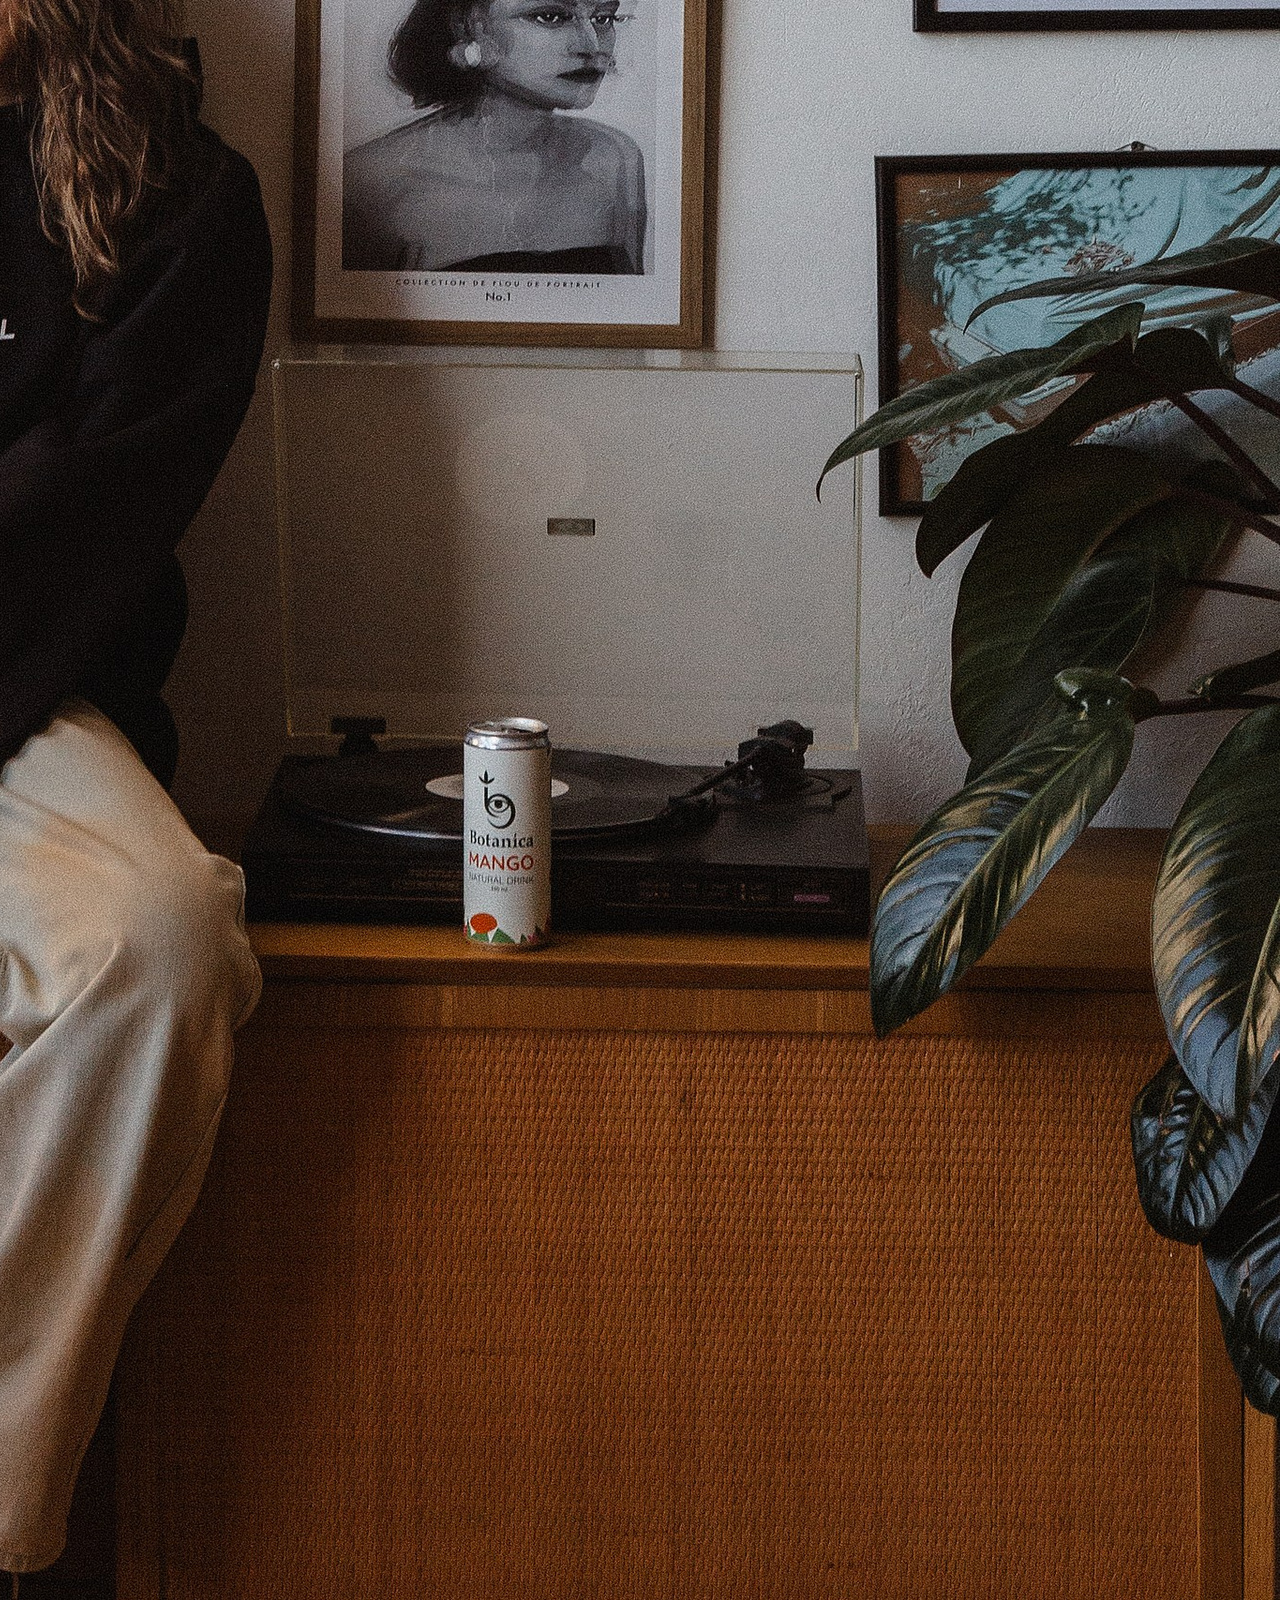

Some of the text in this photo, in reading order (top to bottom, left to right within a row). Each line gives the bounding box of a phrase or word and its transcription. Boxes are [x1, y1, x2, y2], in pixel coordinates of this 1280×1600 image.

[485, 292, 511, 302] No.1
[470, 829, 534, 848] Botanica
[468, 851, 534, 871] MANGO
[469, 872, 534, 886] NATURAL DRINK
